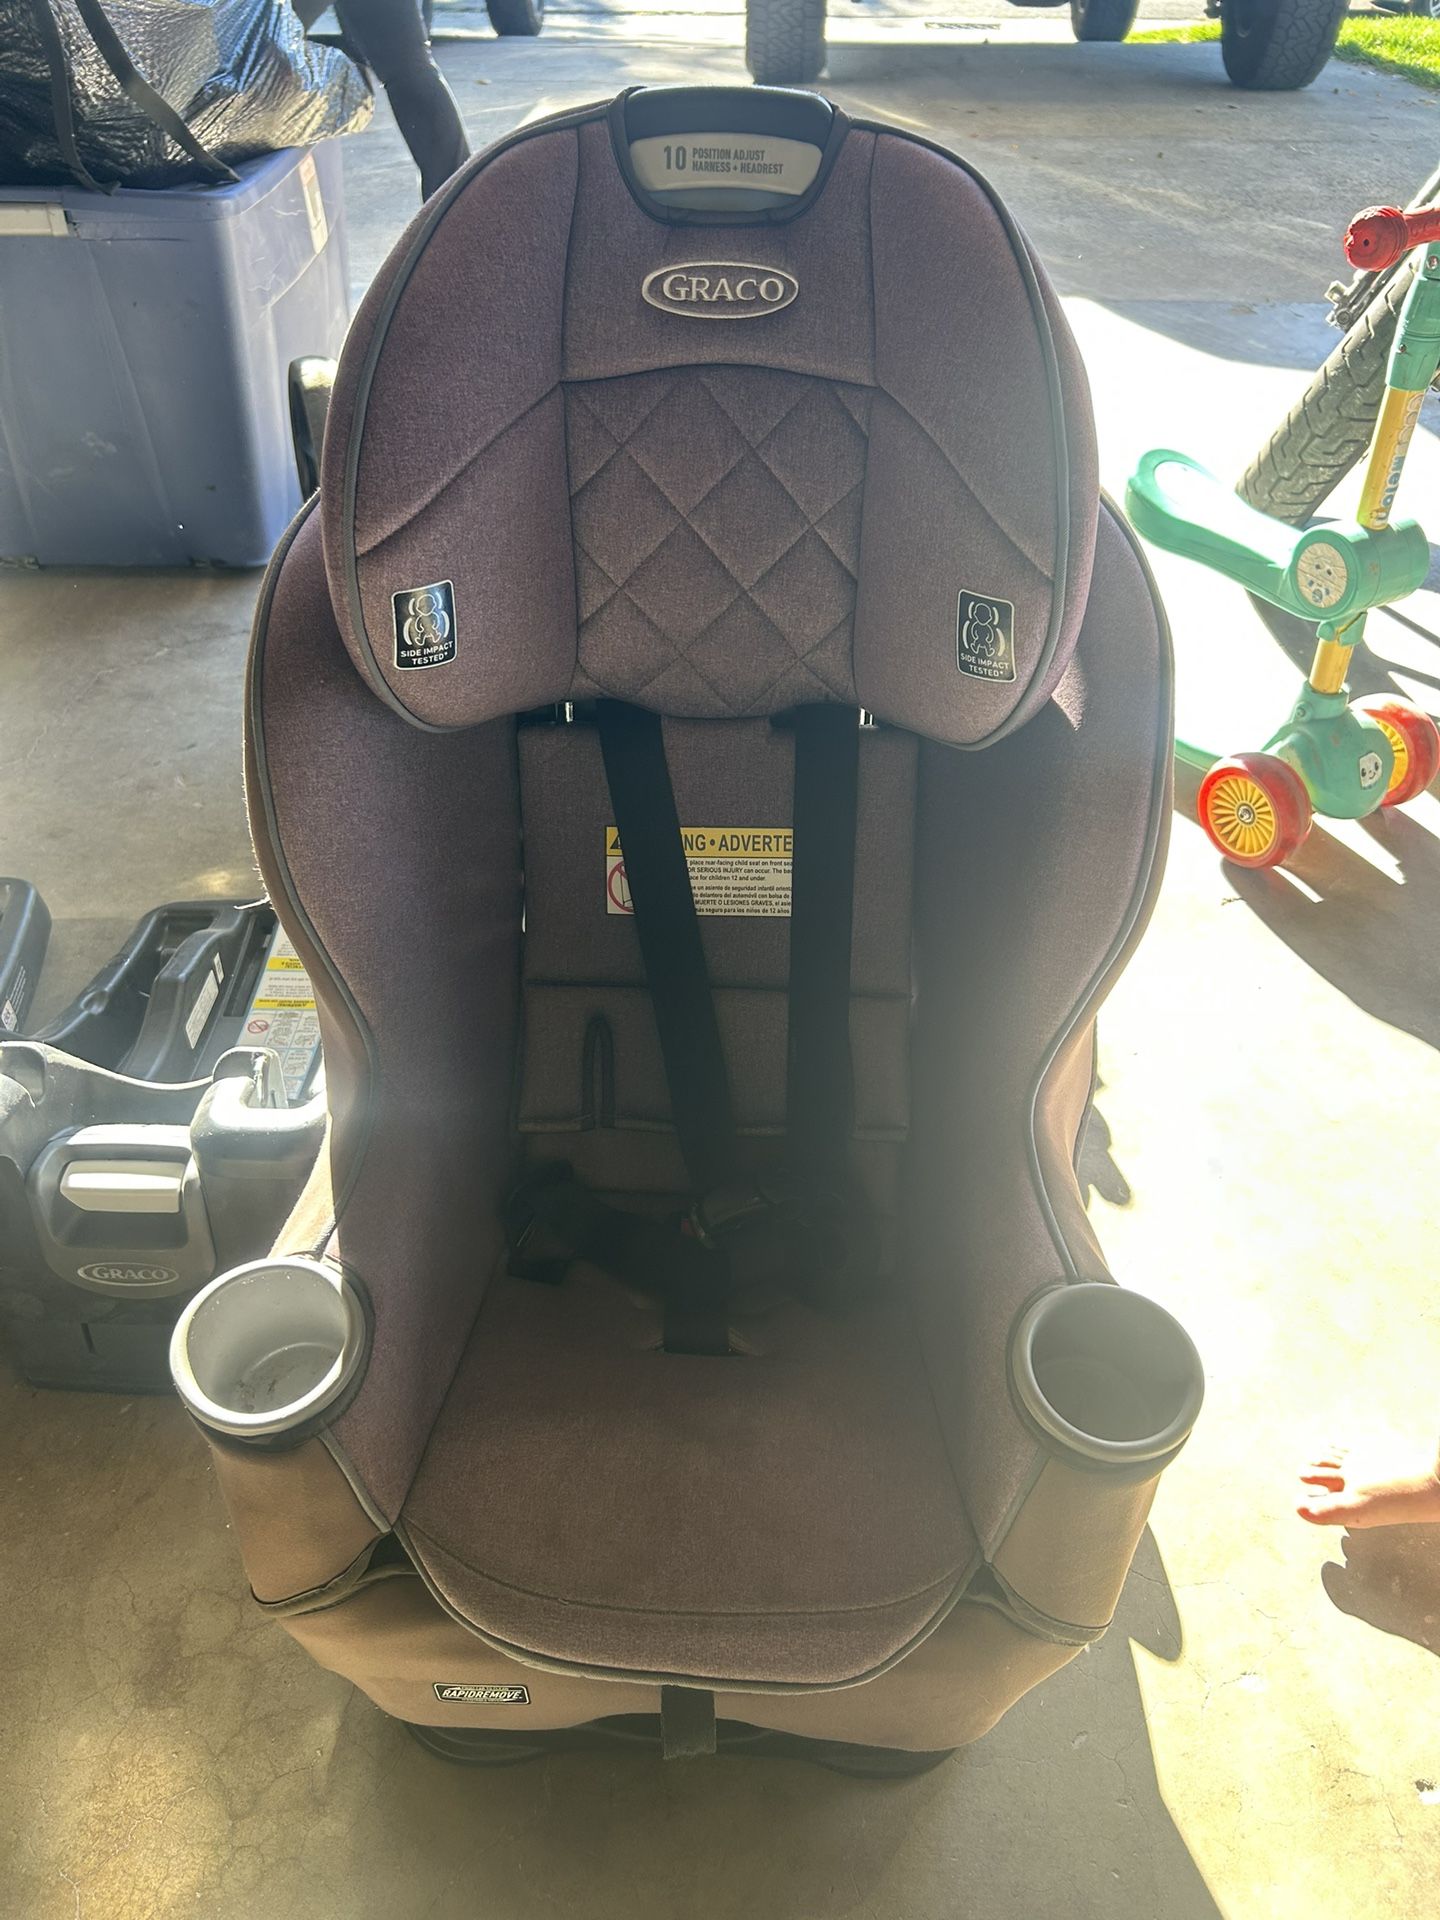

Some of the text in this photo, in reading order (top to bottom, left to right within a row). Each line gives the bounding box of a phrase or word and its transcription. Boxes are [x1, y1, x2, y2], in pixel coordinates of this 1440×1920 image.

[664, 145, 687, 170] 10
[692, 148, 766, 161] POSITION ADJUST
[692, 160, 731, 172] HARNESS
[740, 162, 784, 174] HEADREST
[662, 274, 784, 302] GRACO
[400, 640, 454, 658] SIDE IMPACT
[960, 653, 1009, 670] SIDE IMPACT
[718, 834, 792, 852] ADVERTE
[92, 1266, 169, 1280] GRACO
